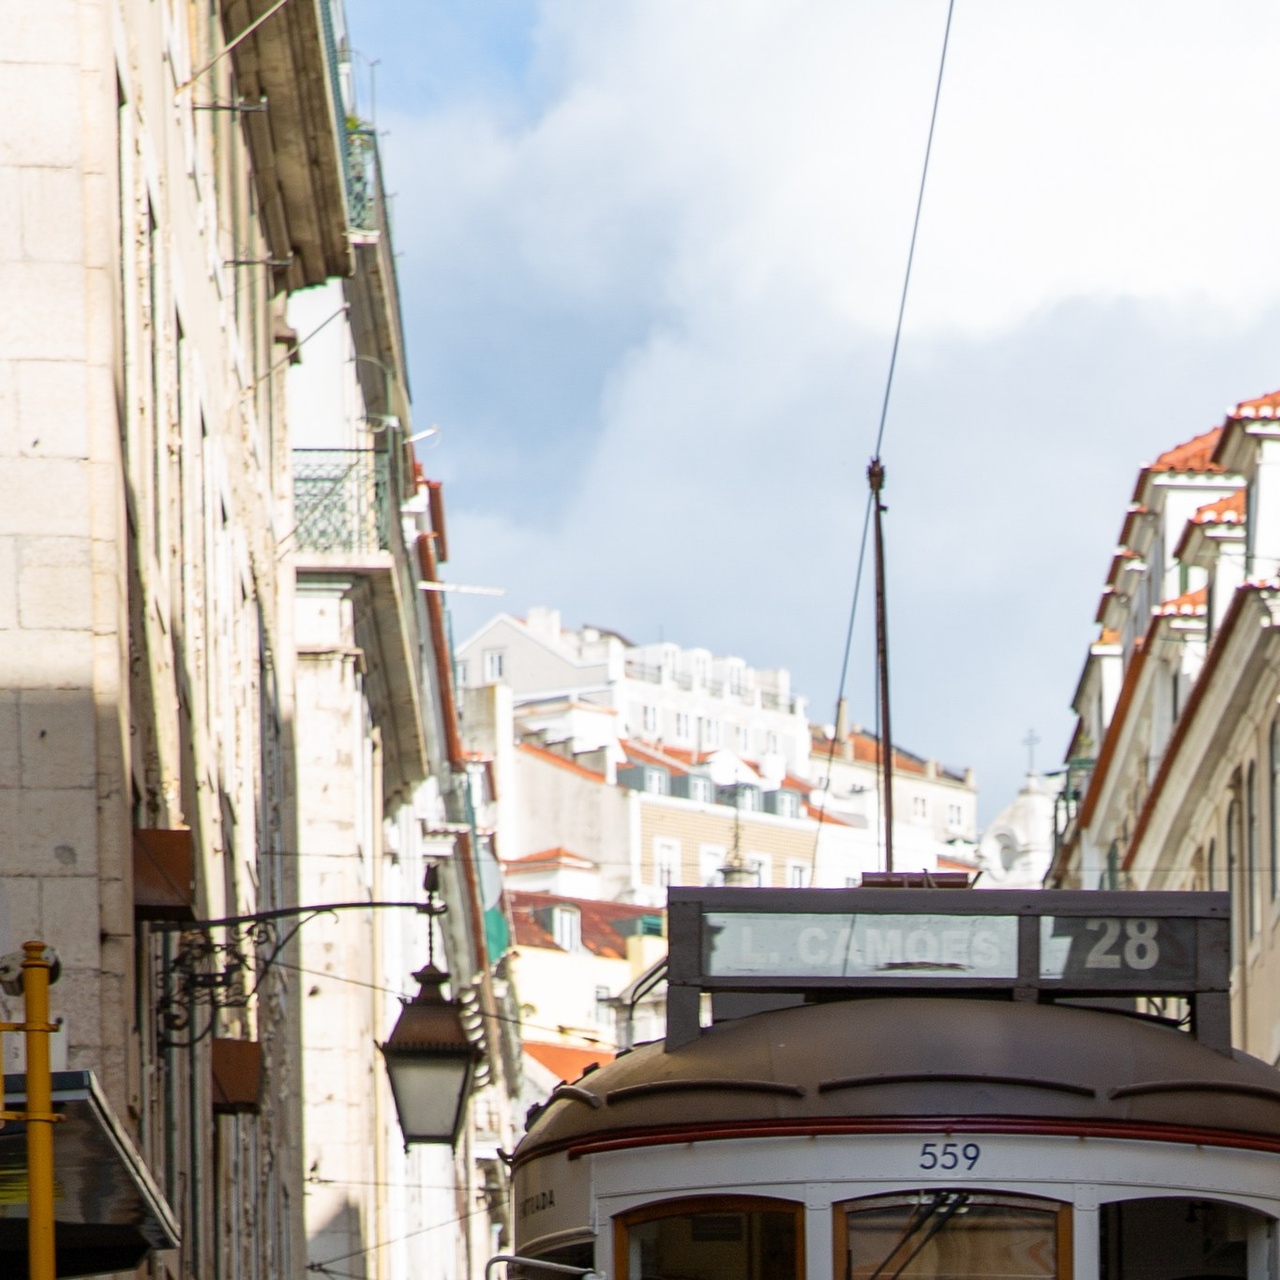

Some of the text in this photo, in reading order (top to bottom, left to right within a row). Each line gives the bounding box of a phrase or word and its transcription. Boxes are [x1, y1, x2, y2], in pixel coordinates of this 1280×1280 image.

[740, 928, 779, 964] L.
[1085, 918, 1160, 970] 28
[919, 1142, 980, 1171] 559
